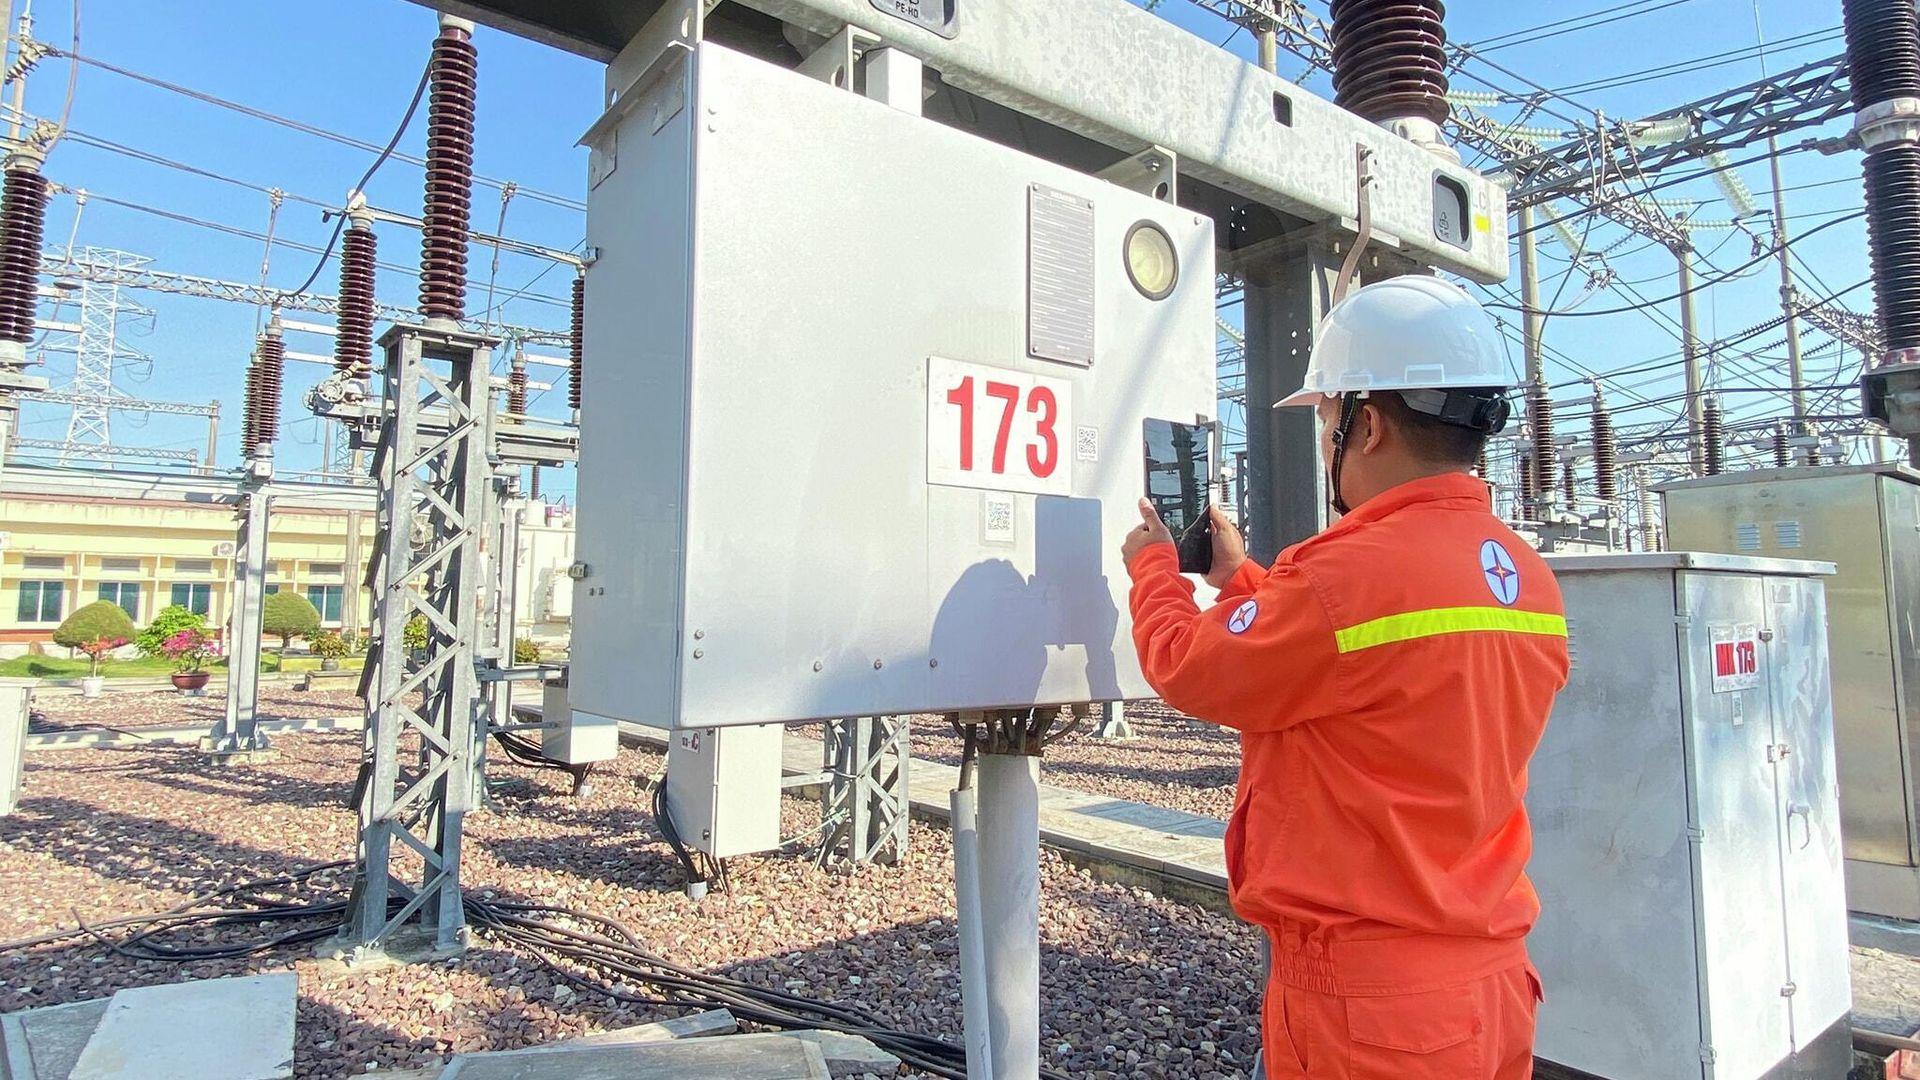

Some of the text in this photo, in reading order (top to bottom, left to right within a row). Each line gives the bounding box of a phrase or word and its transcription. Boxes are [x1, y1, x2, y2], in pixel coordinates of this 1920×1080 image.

[895, 1, 919, 18] PE-HD
[947, 375, 1058, 478] 173
[1736, 641, 1755, 674] 173
